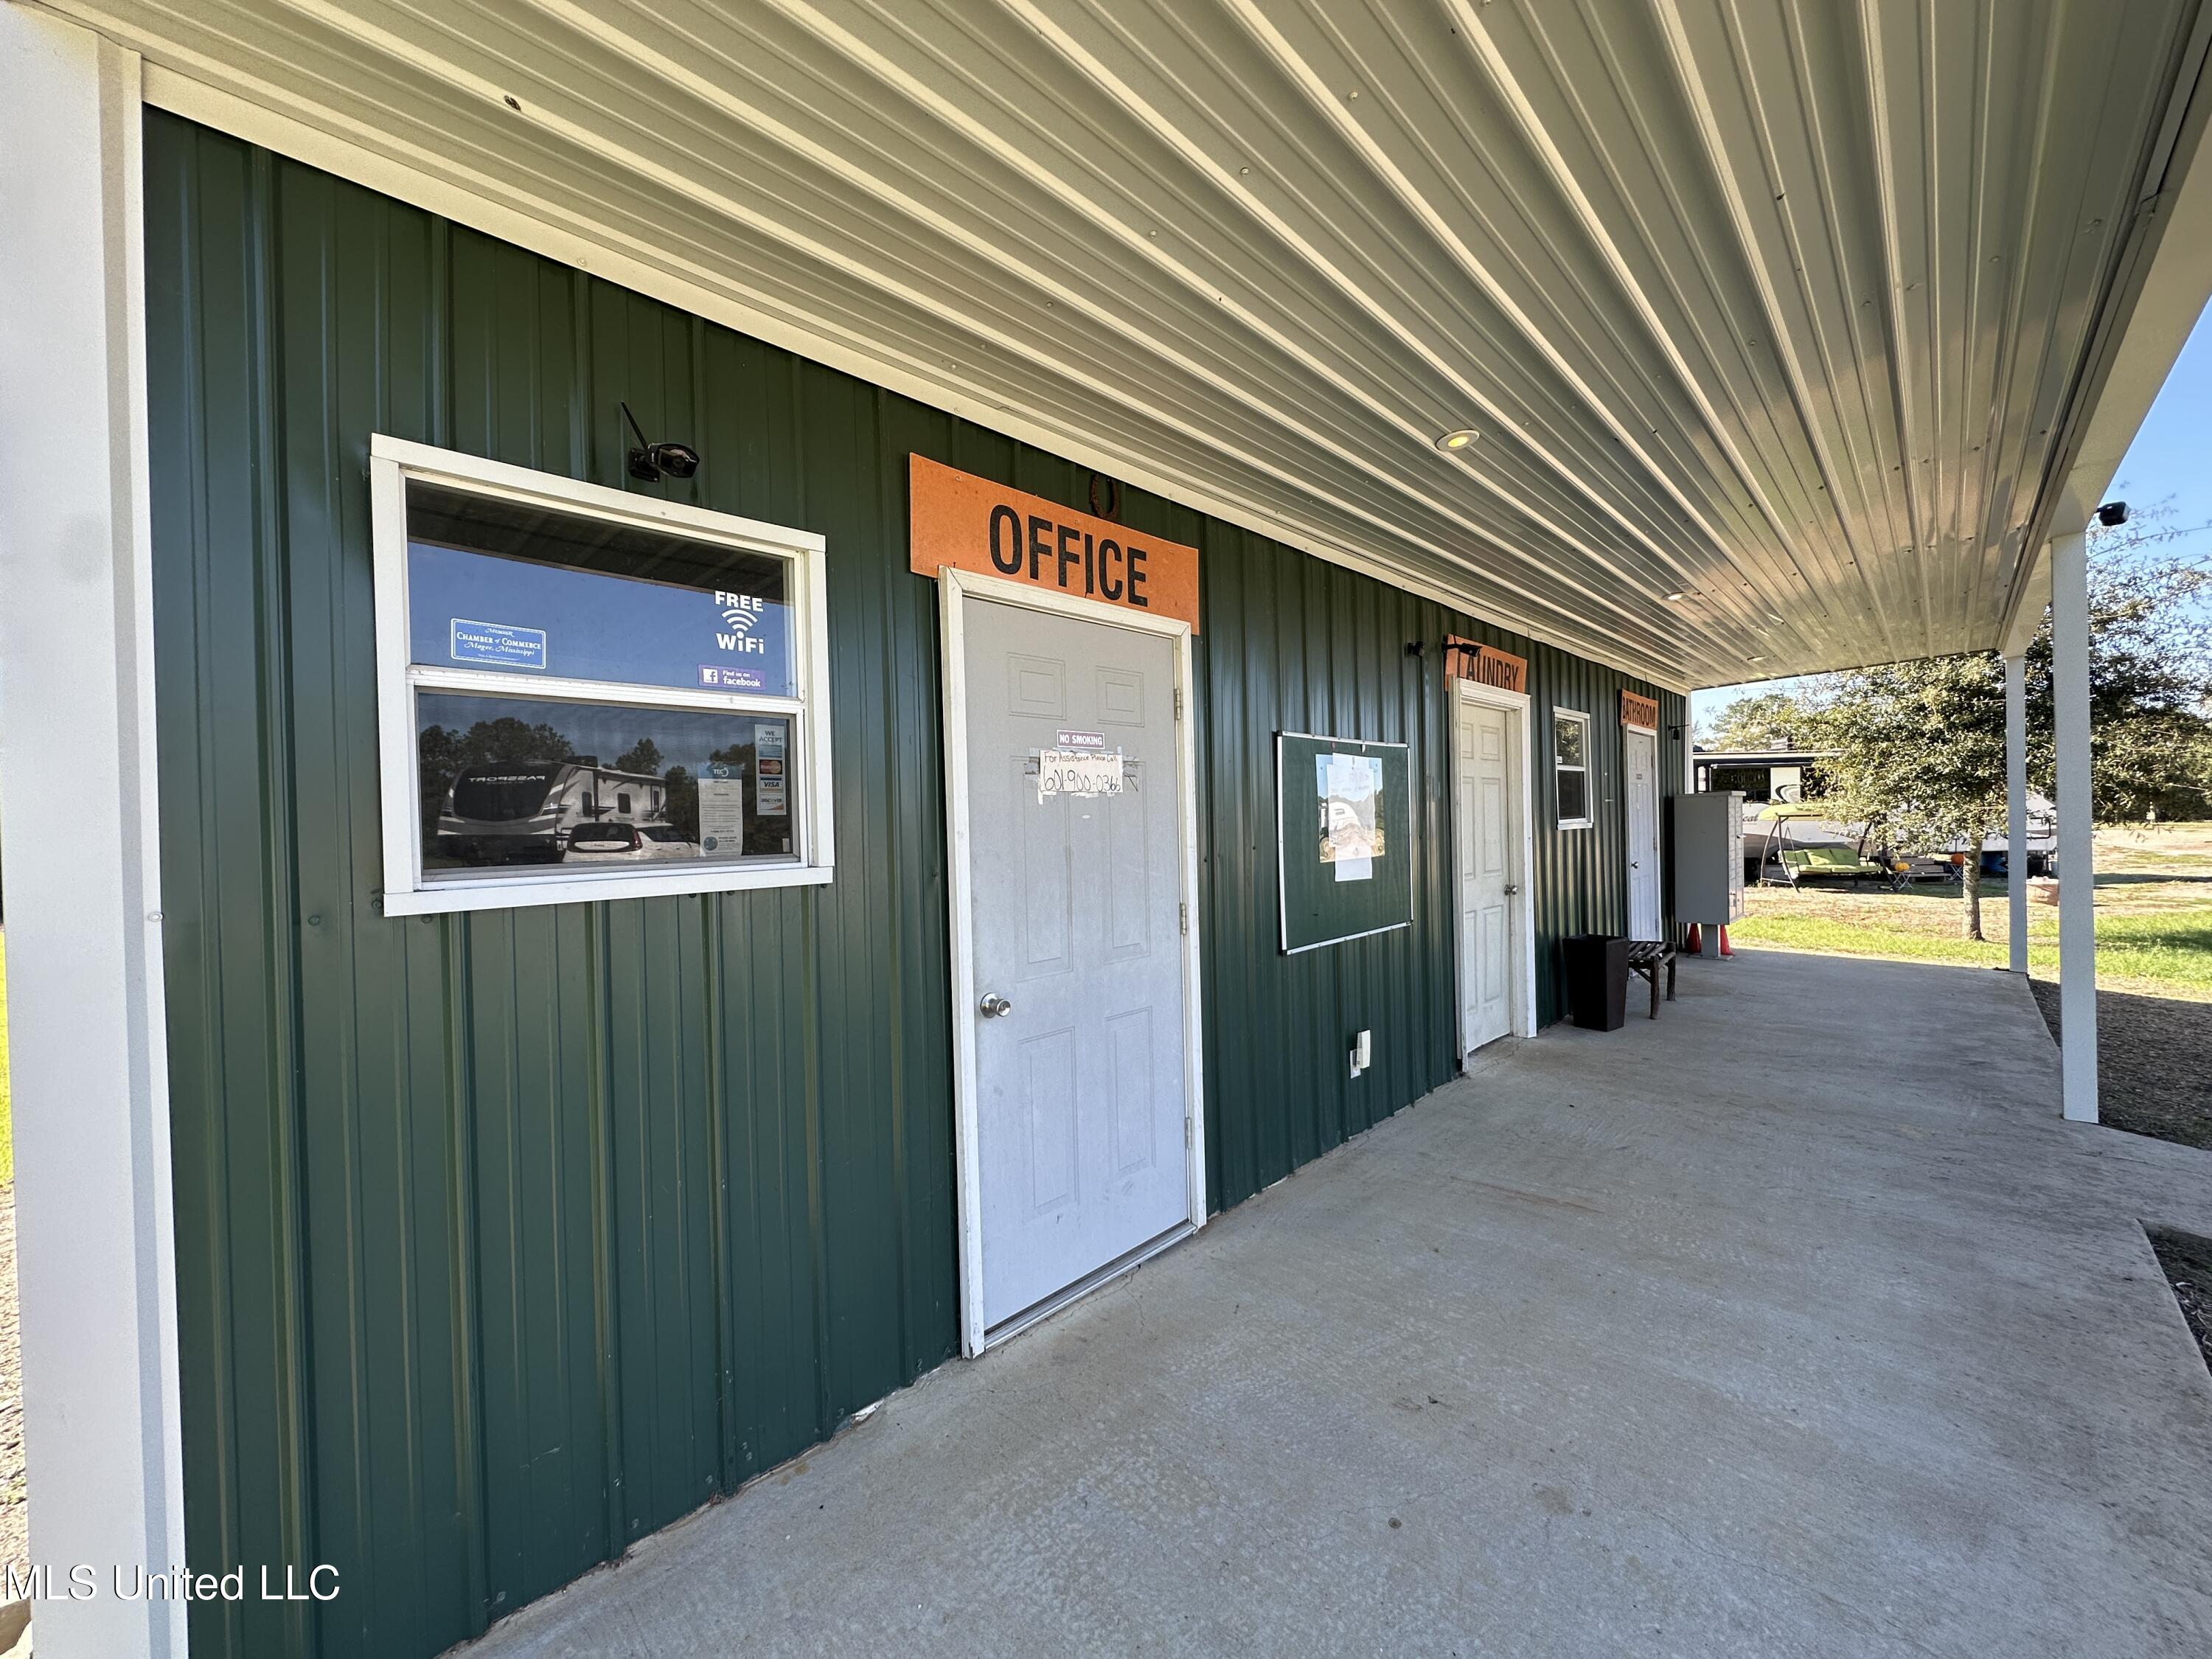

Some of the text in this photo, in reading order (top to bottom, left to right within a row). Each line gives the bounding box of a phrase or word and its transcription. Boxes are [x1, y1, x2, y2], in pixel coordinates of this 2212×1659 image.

[989, 504, 1148, 608] OFFICE
[714, 591, 763, 612] FREE
[457, 632, 493, 644] CHAMBER
[501, 638, 541, 650] COMMERCE
[716, 631, 764, 654] WiFi
[495, 646, 535, 656] Mississippi
[723, 676, 761, 687] facebook
[1622, 696, 1656, 728] BATHROOM
[1060, 734, 1103, 745] NO SMOKING
[1044, 751, 1057, 762] For
[1059, 751, 1089, 762] Assistance
[1107, 754, 1118, 762] Call
[1043, 765, 1121, 792] 601-900-0366
